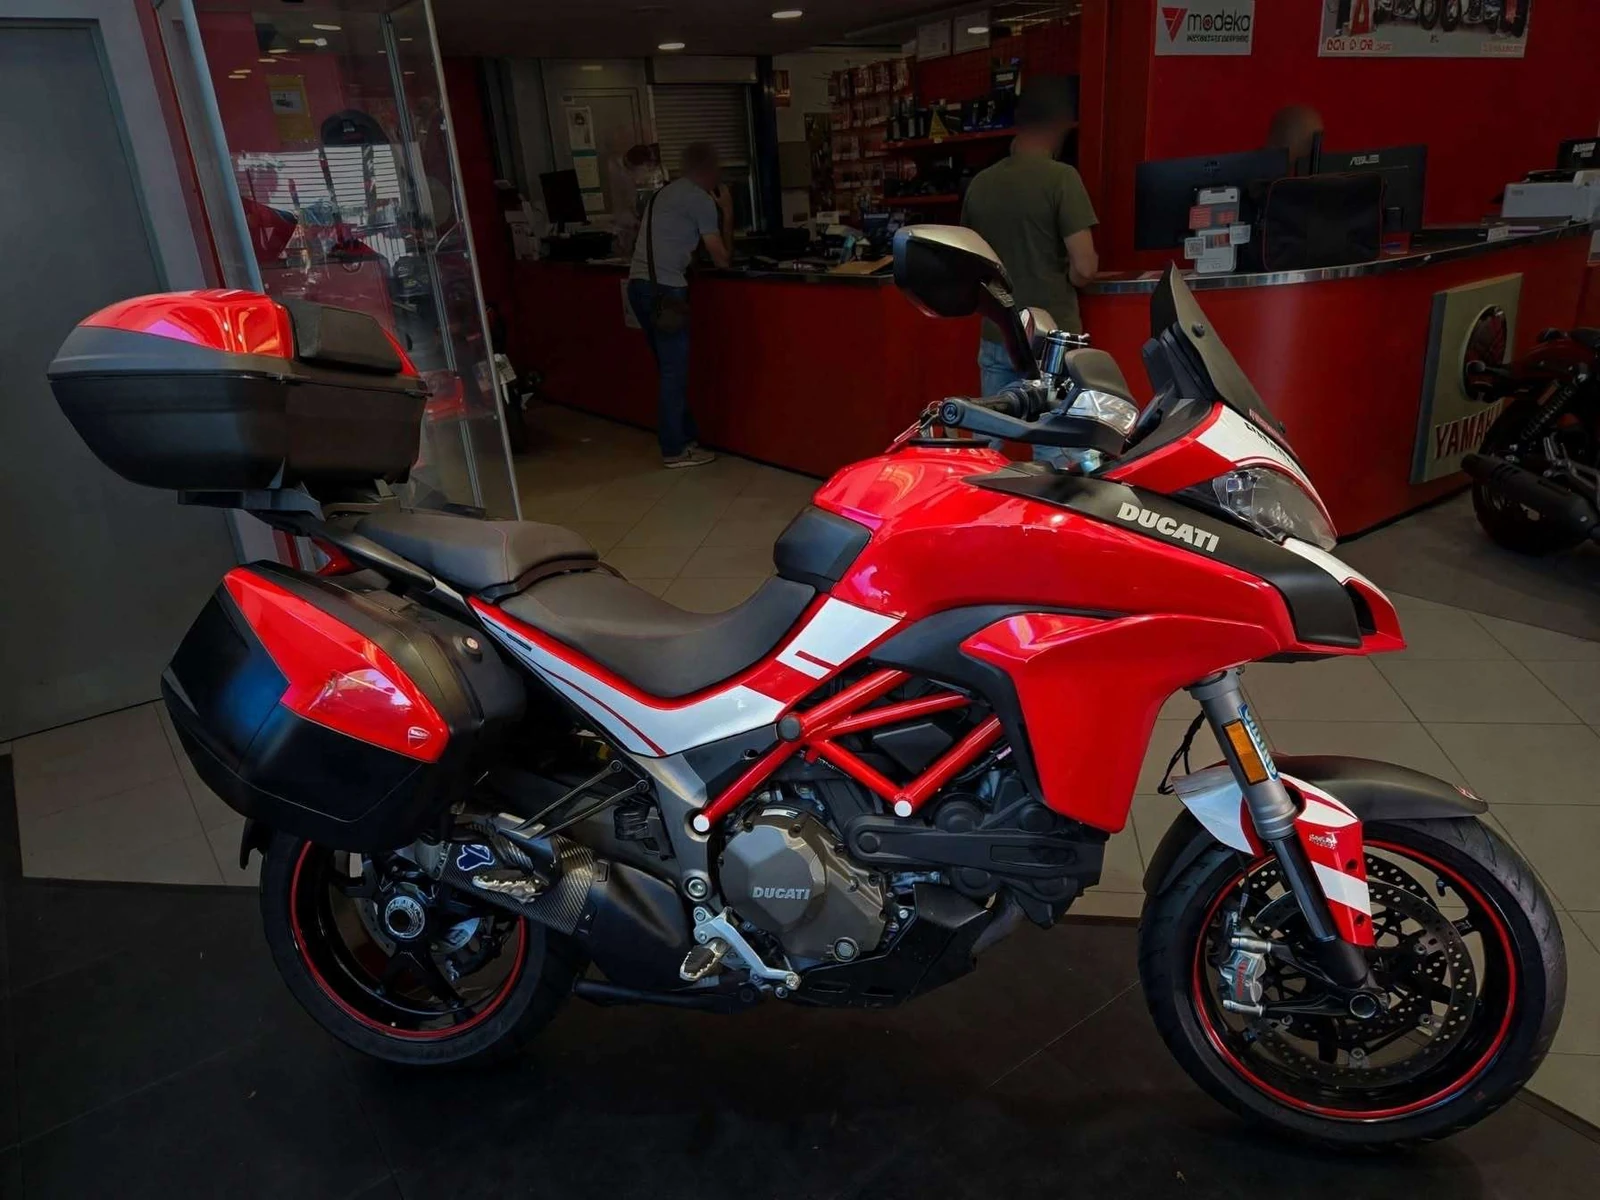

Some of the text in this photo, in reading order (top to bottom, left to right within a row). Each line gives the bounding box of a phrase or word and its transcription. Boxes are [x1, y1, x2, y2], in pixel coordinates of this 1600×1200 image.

[1187, 9, 1250, 32] modeka
[1436, 404, 1498, 459] YAMAH
[1117, 502, 1220, 553] DUCATI
[752, 886, 810, 901] DUCATI
